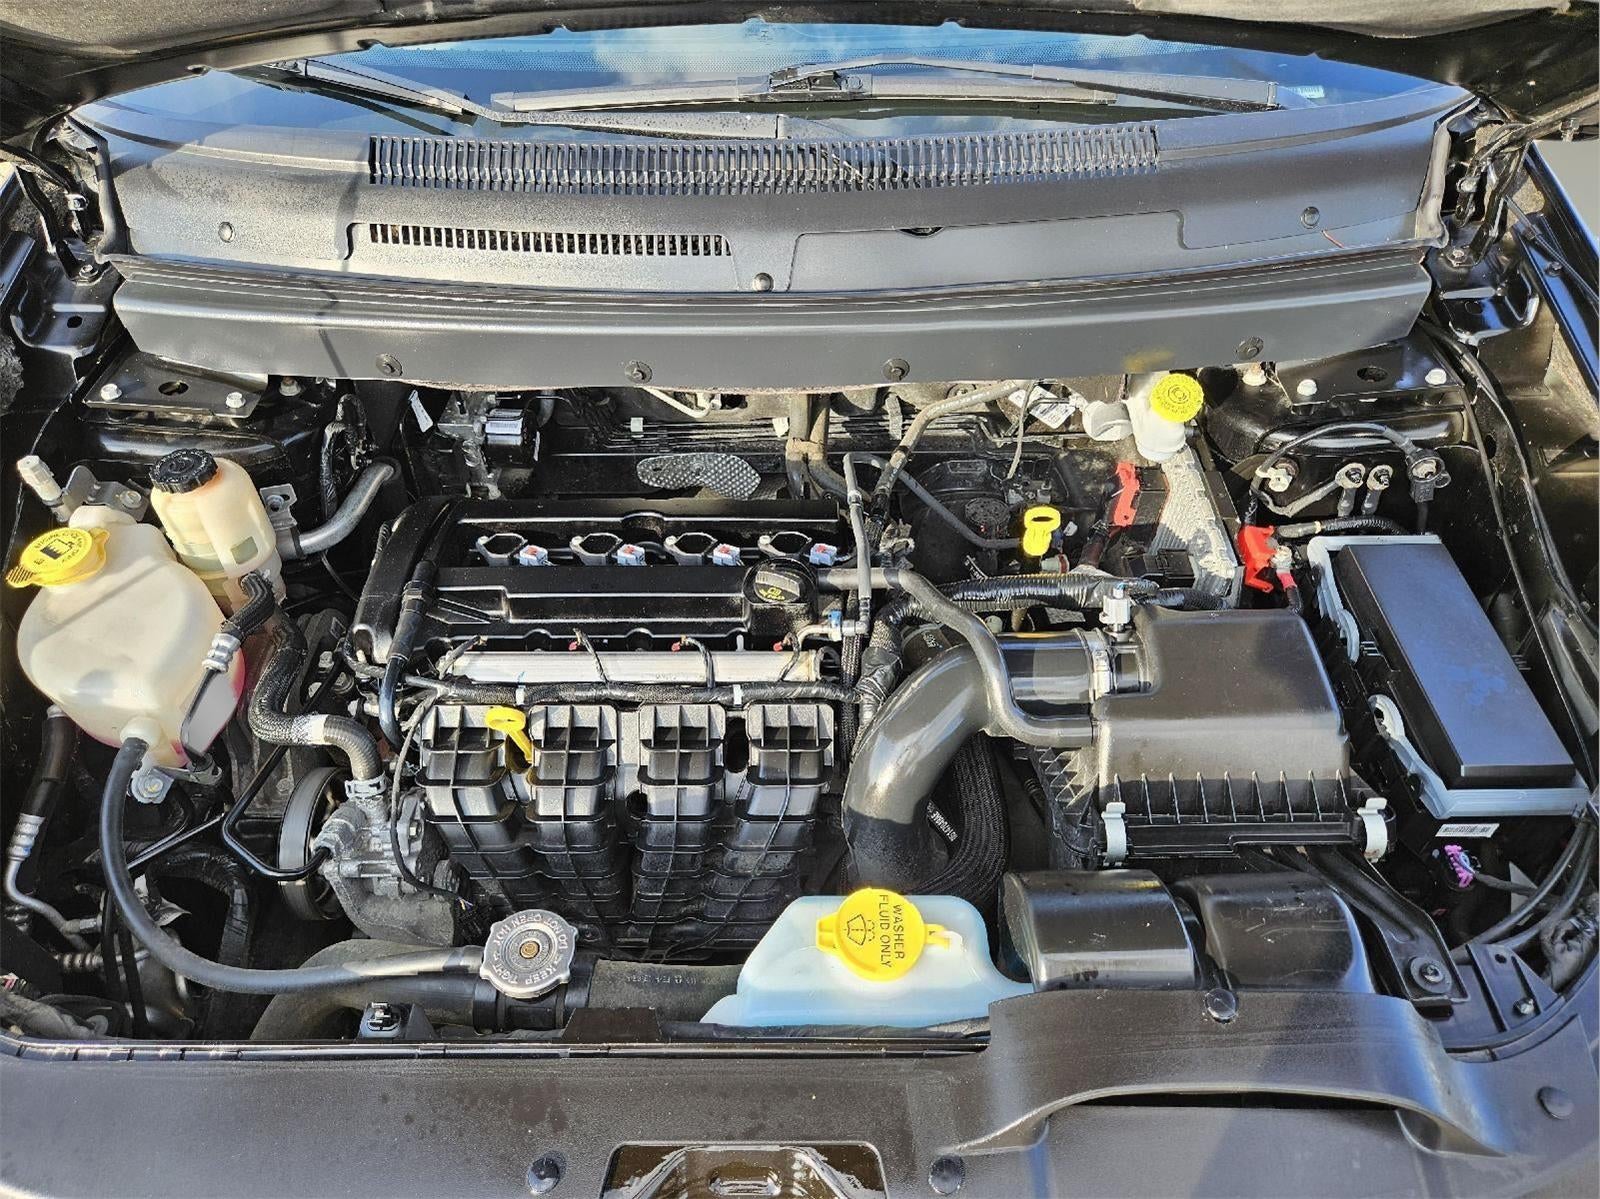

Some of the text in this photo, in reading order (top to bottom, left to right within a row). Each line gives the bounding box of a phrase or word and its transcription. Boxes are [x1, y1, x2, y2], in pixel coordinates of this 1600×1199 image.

[878, 894, 892, 968] FLUID ONLY
[893, 904, 905, 960] WASHER
[525, 965, 557, 985] KEEP
